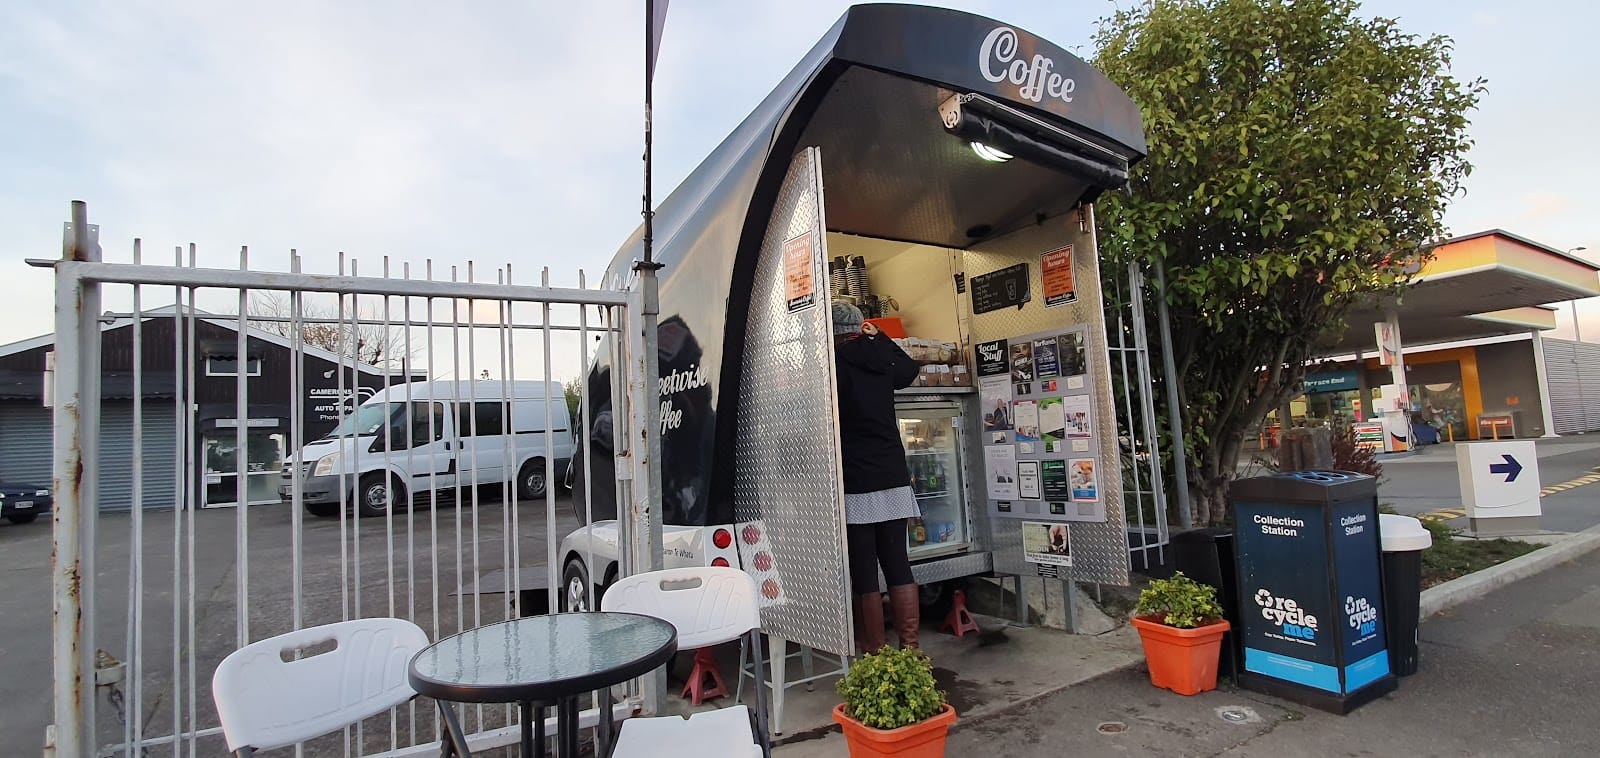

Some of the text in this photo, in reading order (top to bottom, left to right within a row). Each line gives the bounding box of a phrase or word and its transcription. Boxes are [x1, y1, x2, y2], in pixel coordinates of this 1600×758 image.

[979, 26, 1075, 103] Coffee
[977, 341, 999, 354] Local
[983, 349, 1004, 362] Stuff
[658, 363, 709, 397] eetwise
[310, 388, 353, 396] CAMERNS
[659, 399, 682, 436] ffee
[1253, 514, 1305, 528] Collection
[1340, 513, 1367, 527] Collection
[1262, 524, 1298, 537] Station
[1345, 524, 1364, 536] Station
[1275, 597, 1298, 612] re
[1355, 597, 1367, 613] re
[1262, 607, 1318, 628] cycle
[1349, 603, 1377, 630] cycle
[1283, 622, 1315, 640] me
[1361, 619, 1376, 636] me
